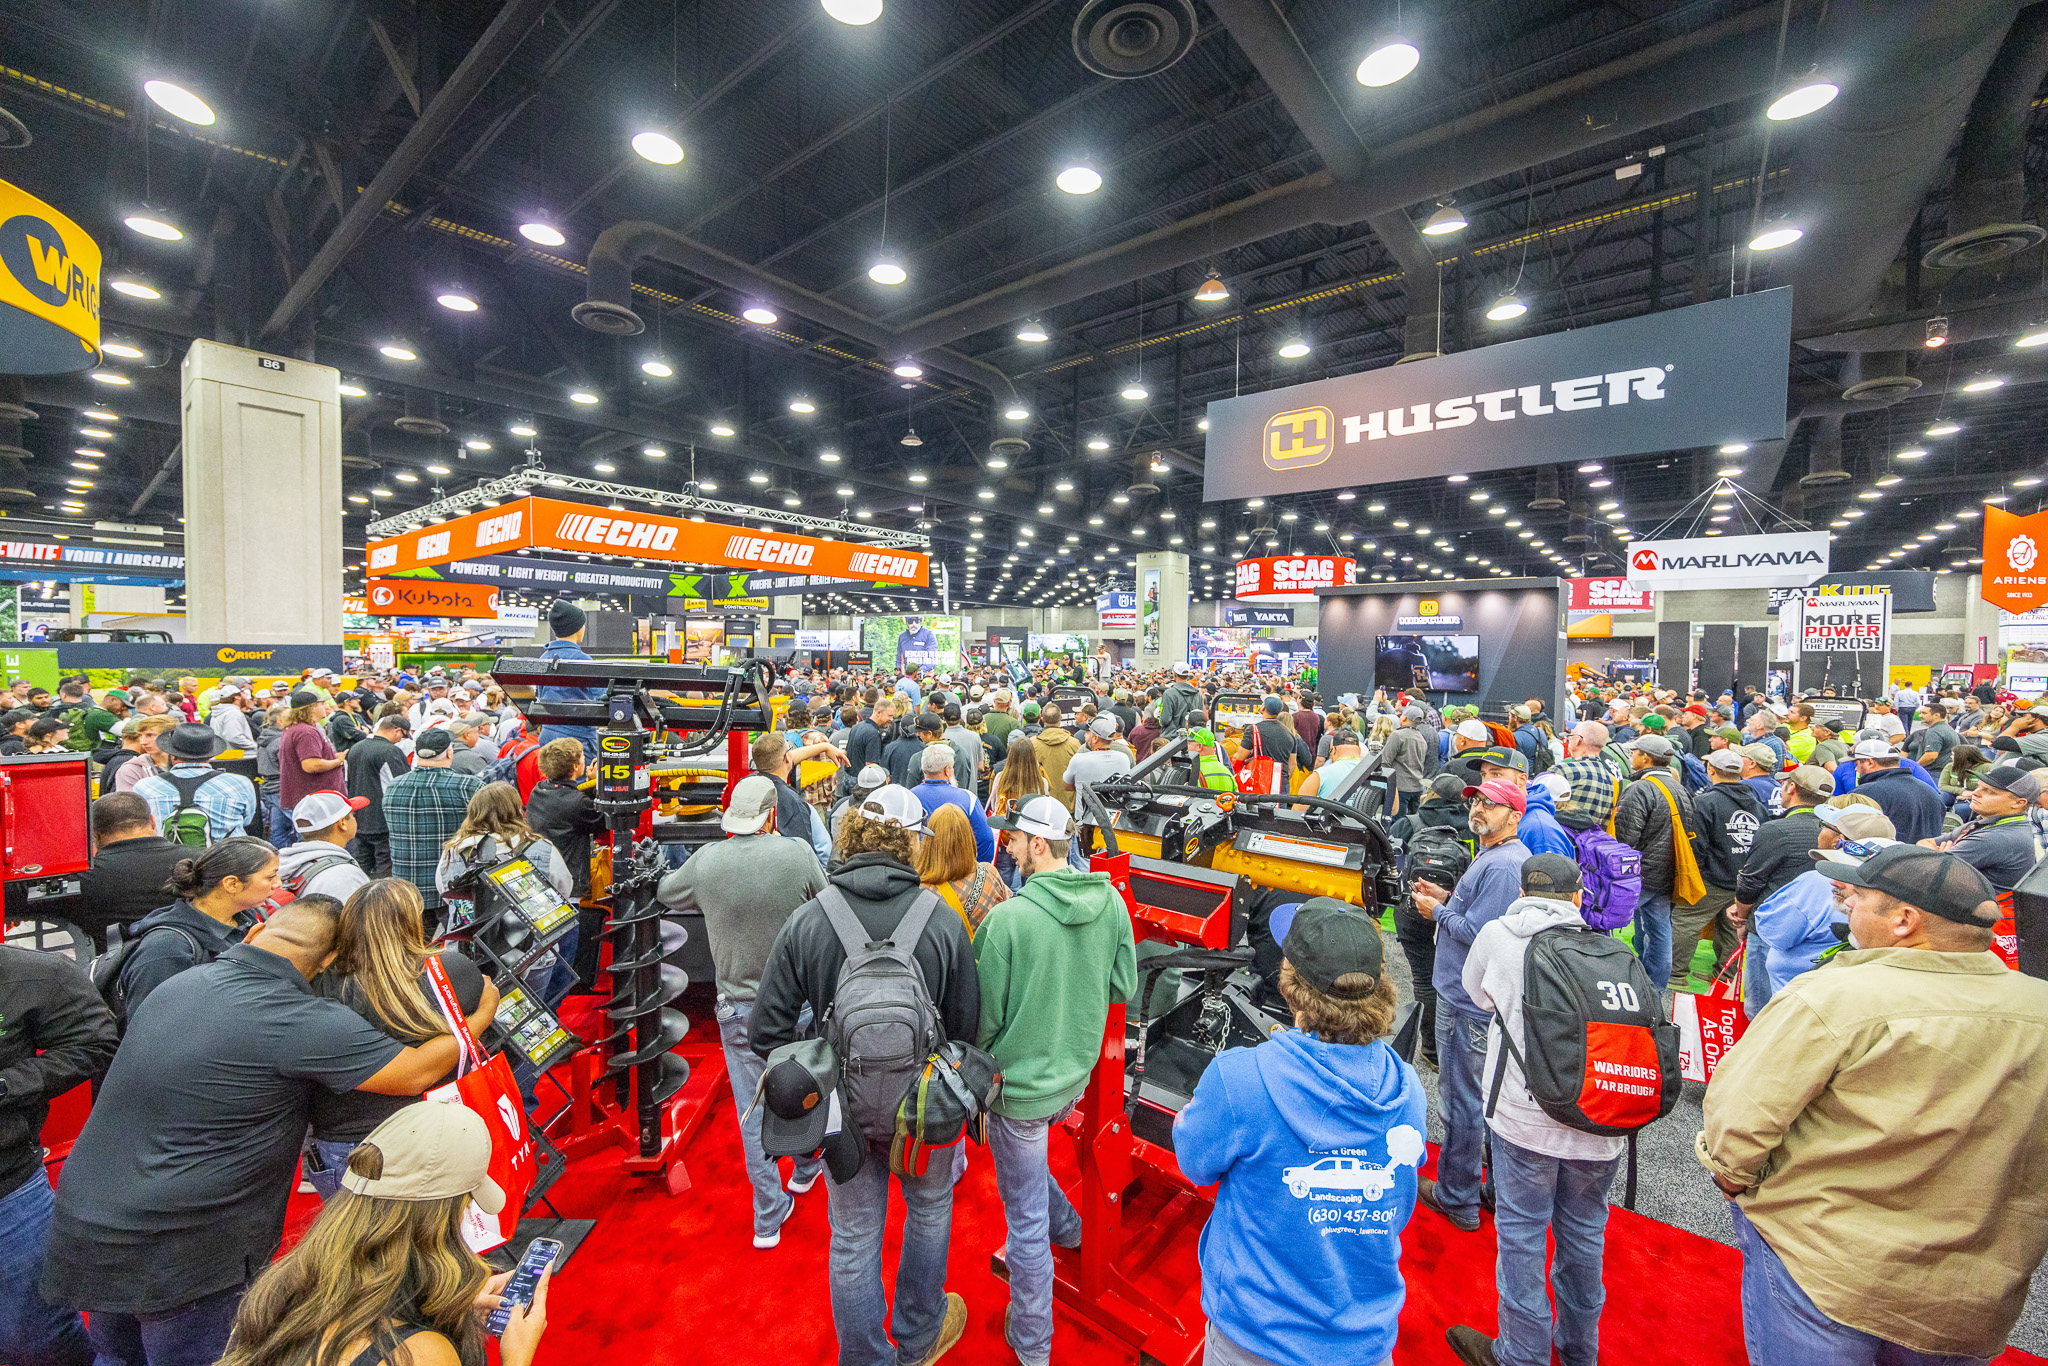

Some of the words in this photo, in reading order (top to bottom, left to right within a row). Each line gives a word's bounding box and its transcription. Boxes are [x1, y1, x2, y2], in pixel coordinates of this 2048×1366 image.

[263, 358, 281, 371] B6
[1343, 366, 1668, 444] HUSTLER
[591, 518, 678, 552] ECHO
[423, 531, 451, 559] ECHO
[749, 540, 816, 567] ECHO
[863, 554, 919, 578] ECHO
[1662, 550, 1825, 570] MARUYAMA
[450, 561, 501, 577] POWERFUL
[507, 566, 534, 580] LIGHT
[535, 569, 568, 582] WEIGHT
[574, 572, 609, 585] GREATER
[609, 575, 663, 589] PRODUCTIVITY
[1273, 559, 1335, 582] SCAG
[775, 577, 788, 588] LIGHT
[788, 575, 807, 587] WEIGHT
[1273, 581, 1297, 590] POWER
[1298, 581, 1334, 589] EQUIPMENT
[1993, 576, 2047, 585] ARIENS
[399, 589, 473, 607] Kubota
[1589, 598, 1612, 606] POWER
[1769, 587, 1818, 601] SEAT
[1254, 611, 1290, 623] YAKTA
[1805, 613, 1881, 626] MORE
[1805, 625, 1880, 637] POWER
[1825, 637, 1880, 650] PROS!
[224, 650, 272, 660] WRIGHT
[601, 765, 630, 779] 15
[1597, 980, 1641, 1012] 30
[1702, 1016, 1718, 1039] As
[1705, 1042, 1720, 1074] One
[1593, 1060, 1657, 1080] WARRIORS
[1594, 1078, 1655, 1096] YARBROUGH
[511, 1141, 530, 1171] TYM
[1340, 1148, 1367, 1156] Green
[1309, 1192, 1363, 1204] Landscaping
[1308, 1207, 1342, 1224] (630)
[1321, 1226, 1389, 1237] @bluegreen_lawncare
